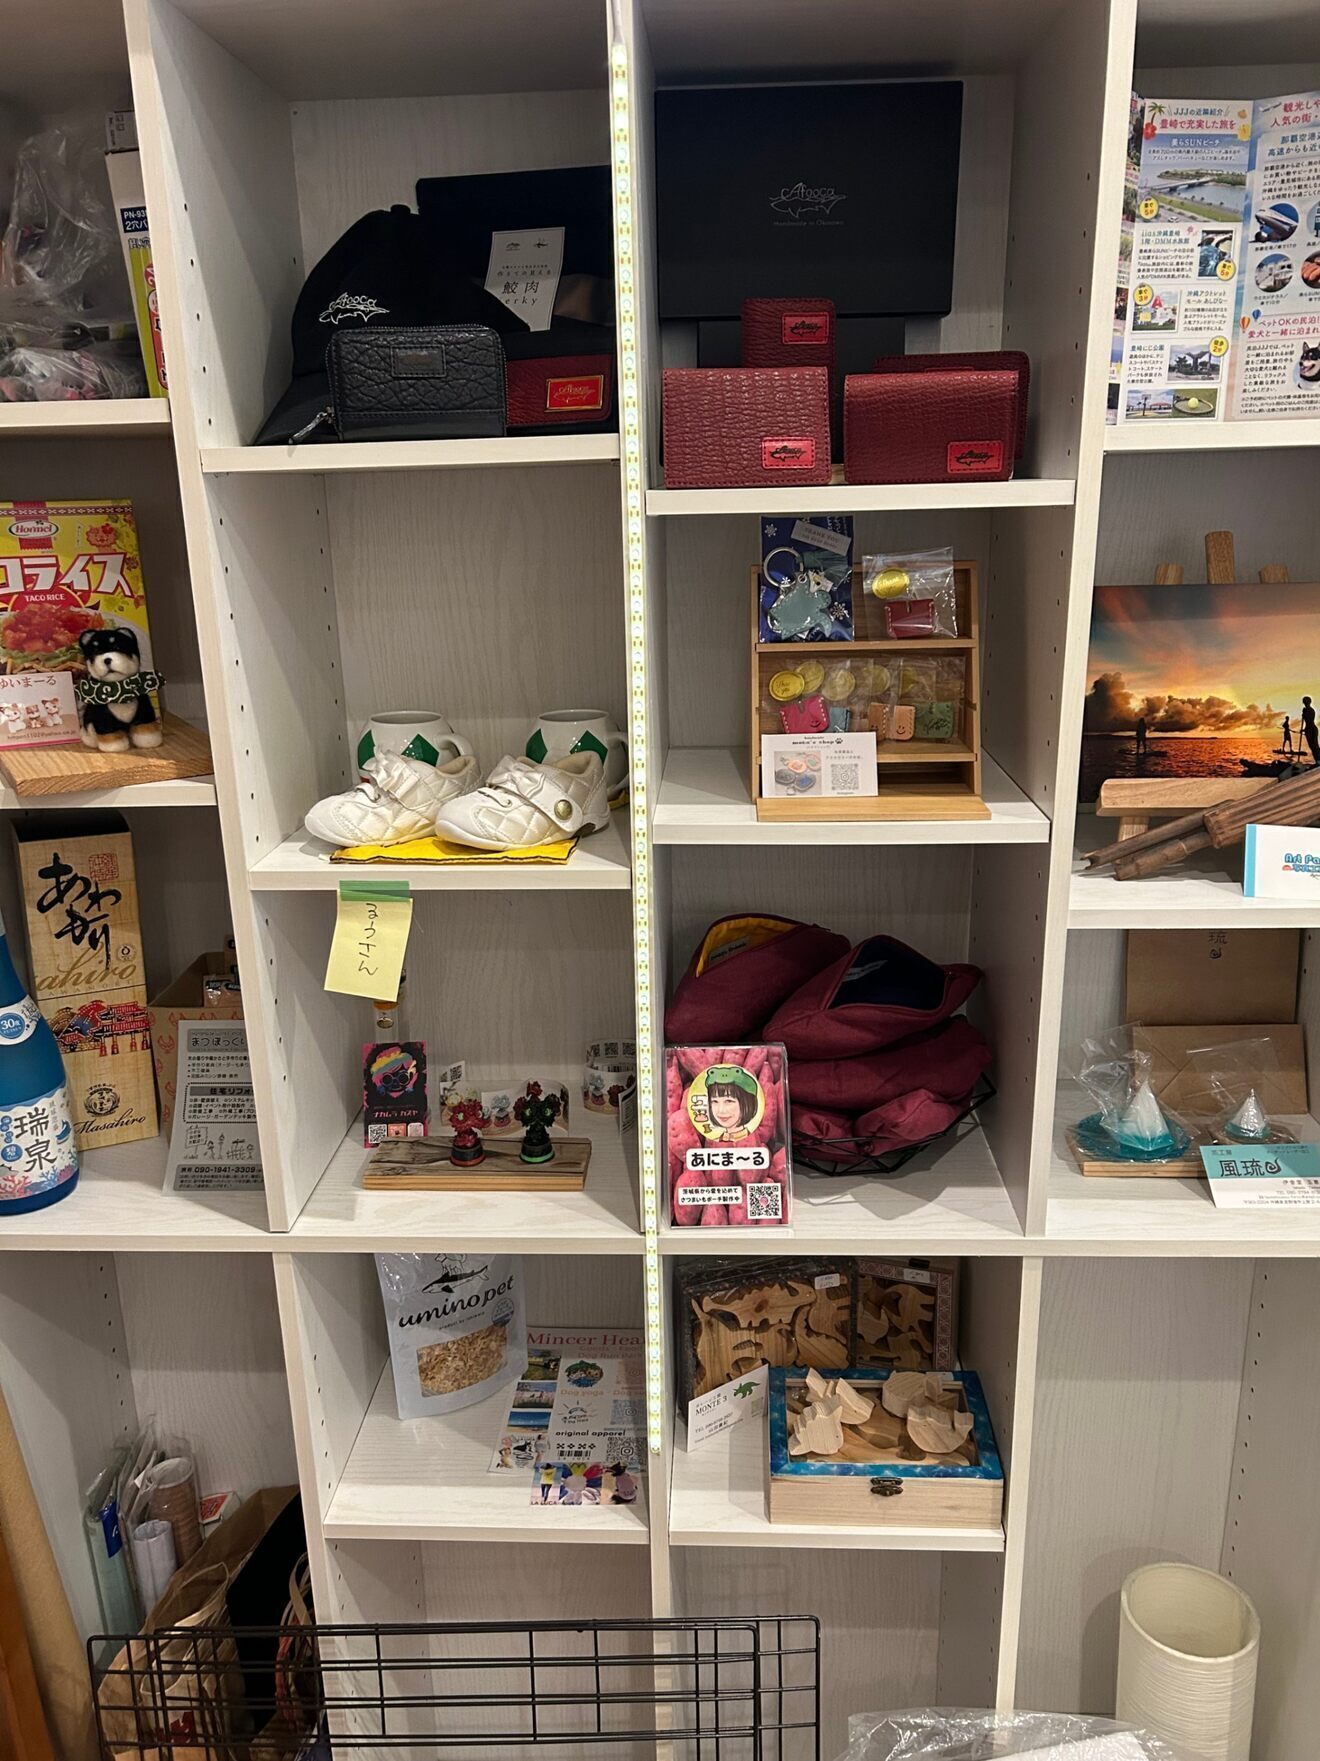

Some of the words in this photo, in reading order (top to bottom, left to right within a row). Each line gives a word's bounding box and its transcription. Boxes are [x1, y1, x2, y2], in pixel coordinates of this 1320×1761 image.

[1160, 119, 1236, 129] 豊崎で充実した旅を
[123, 209, 147, 219] PN-93
[505, 296, 538, 305] erky
[24, 594, 46, 602] TACO
[210, 1087, 254, 1095] 住宅リフォ
[73, 1108, 146, 1134] Masahiro
[14, 1106, 57, 1172] 瑞泉
[528, 1332, 597, 1345] Mincer
[695, 1399, 722, 1416] MONTE
[591, 1429, 626, 1437] apparel
